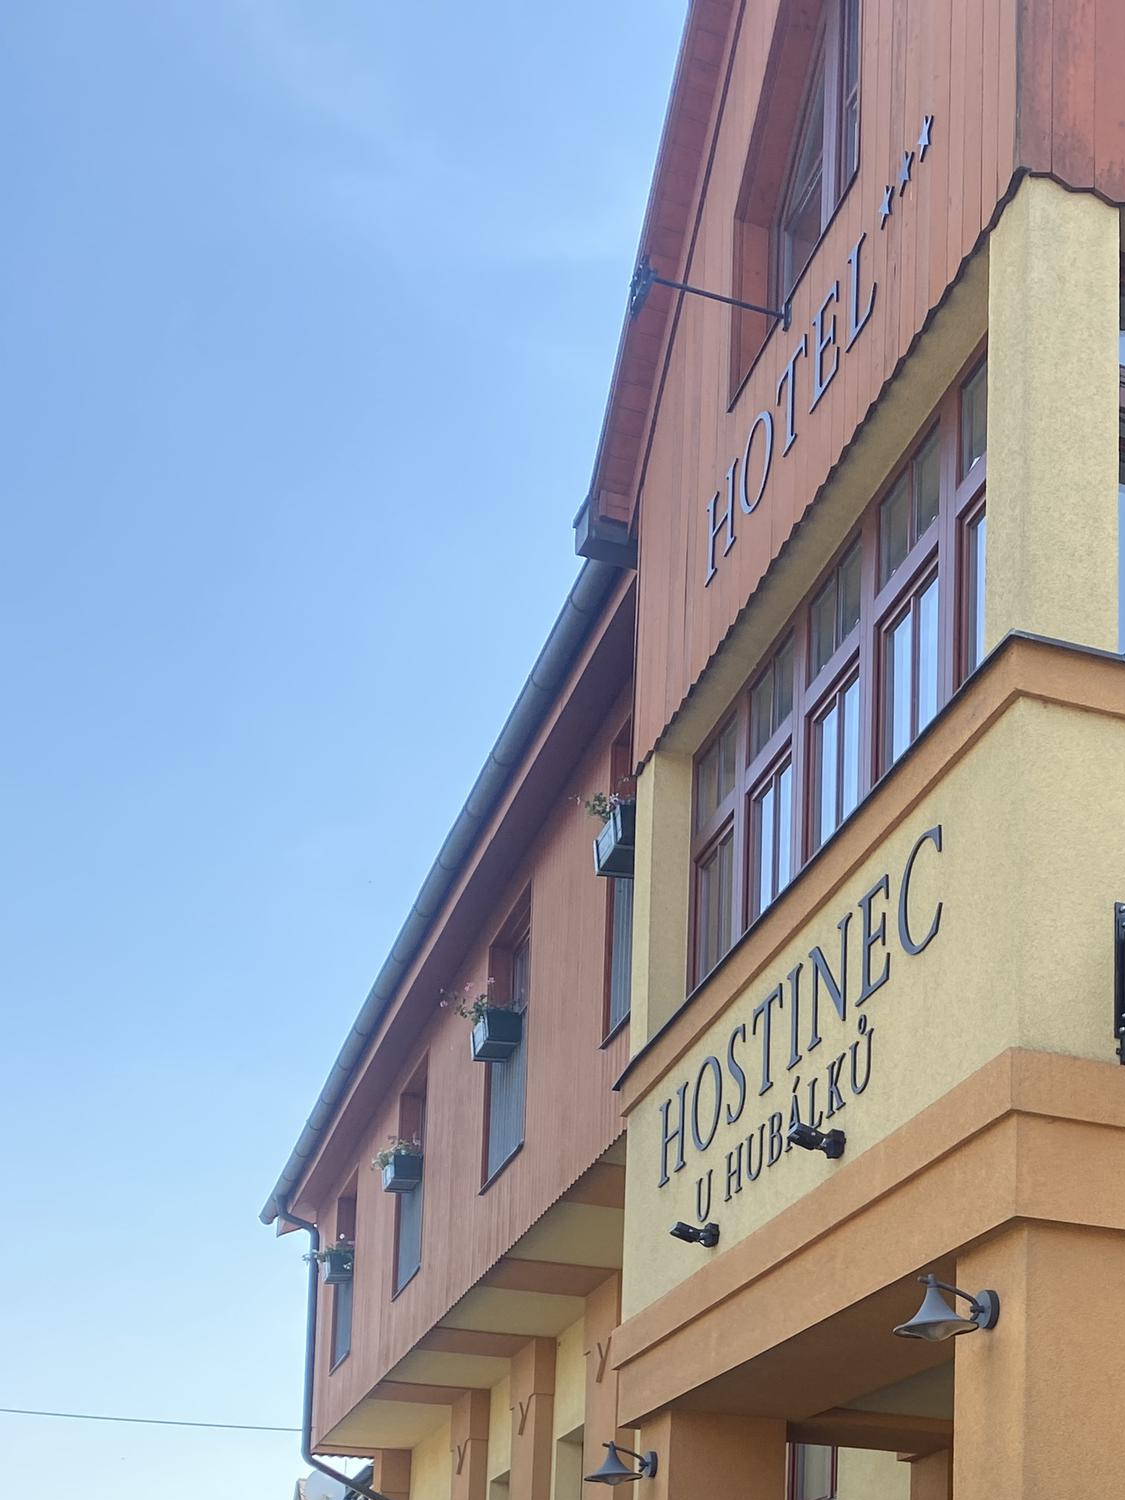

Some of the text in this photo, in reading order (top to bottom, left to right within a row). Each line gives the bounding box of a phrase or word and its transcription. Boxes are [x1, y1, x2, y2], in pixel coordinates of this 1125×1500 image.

[705, 232, 877, 588] HOTEL
[657, 824, 943, 1189] HOSTINEC
[695, 1013, 874, 1223] U HUBÁLKŮ
